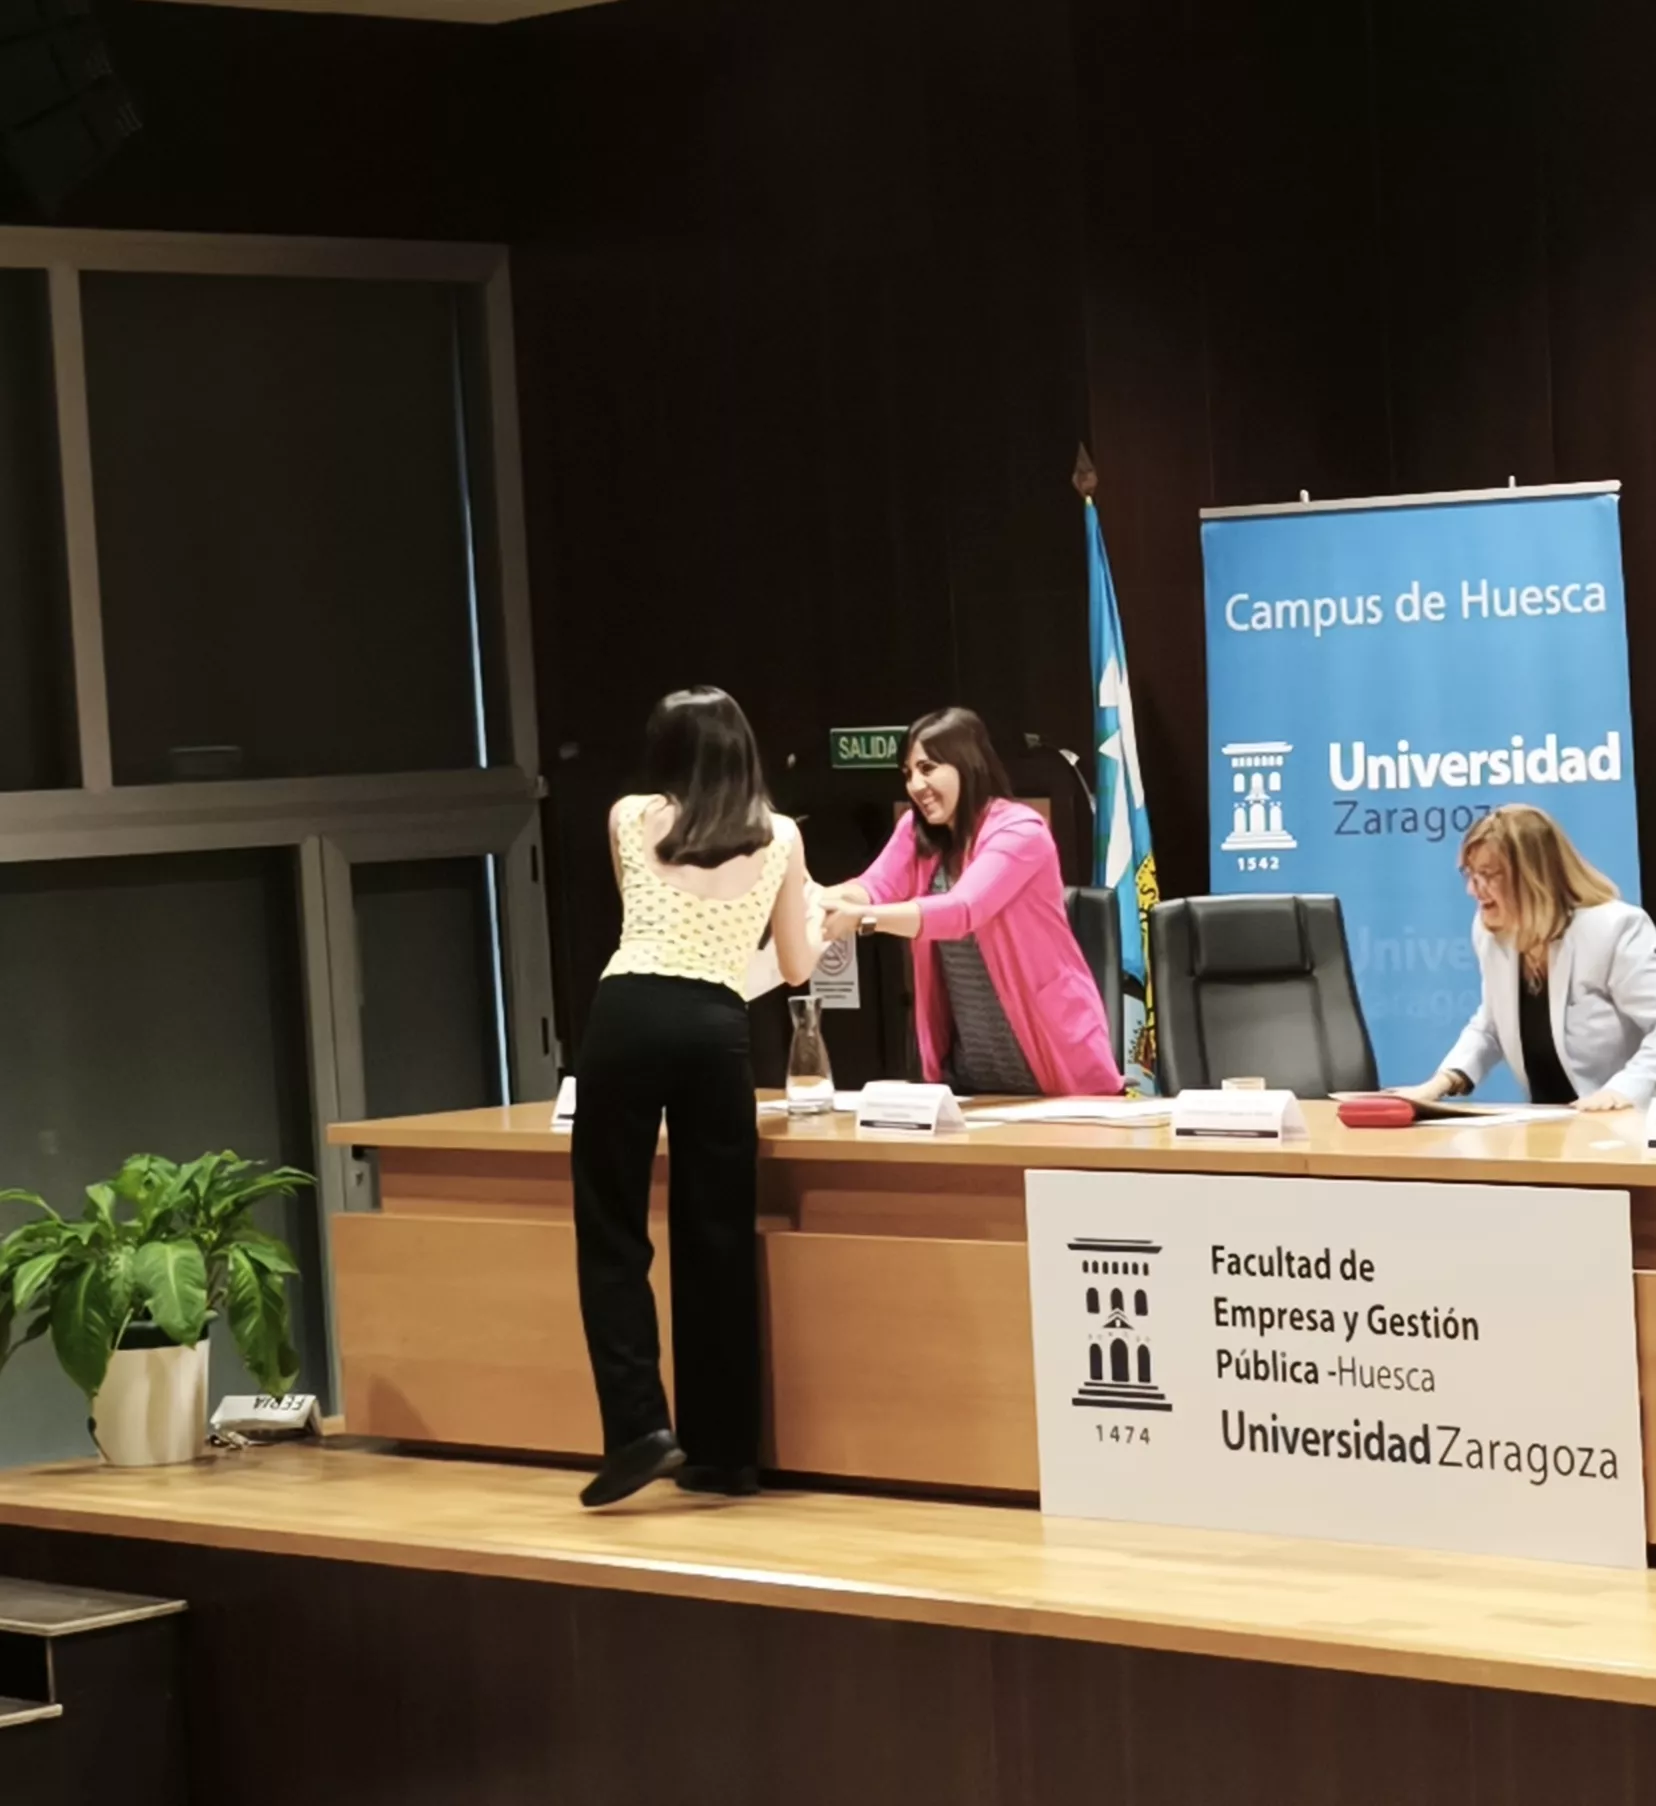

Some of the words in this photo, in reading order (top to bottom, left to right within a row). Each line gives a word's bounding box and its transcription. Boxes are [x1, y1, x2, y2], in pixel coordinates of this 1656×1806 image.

[1224, 592, 1383, 638] Campus
[1395, 581, 1447, 623] de
[1460, 578, 1607, 620] Huesca
[838, 736, 898, 760] SALIDA
[1328, 731, 1622, 792] Universidad
[1332, 800, 1505, 843] Zarago
[1237, 856, 1280, 872] 1542
[1211, 1245, 1332, 1280] Facultad
[1339, 1249, 1376, 1283] de
[1213, 1296, 1336, 1337] Empresa
[1342, 1308, 1360, 1342] y
[1366, 1303, 1480, 1342] Gestión
[1215, 1348, 1319, 1386] Pública
[1095, 1424, 1151, 1445] 1474
[1221, 1409, 1432, 1466] Universidad
[1436, 1425, 1620, 1486] Zaragoza
